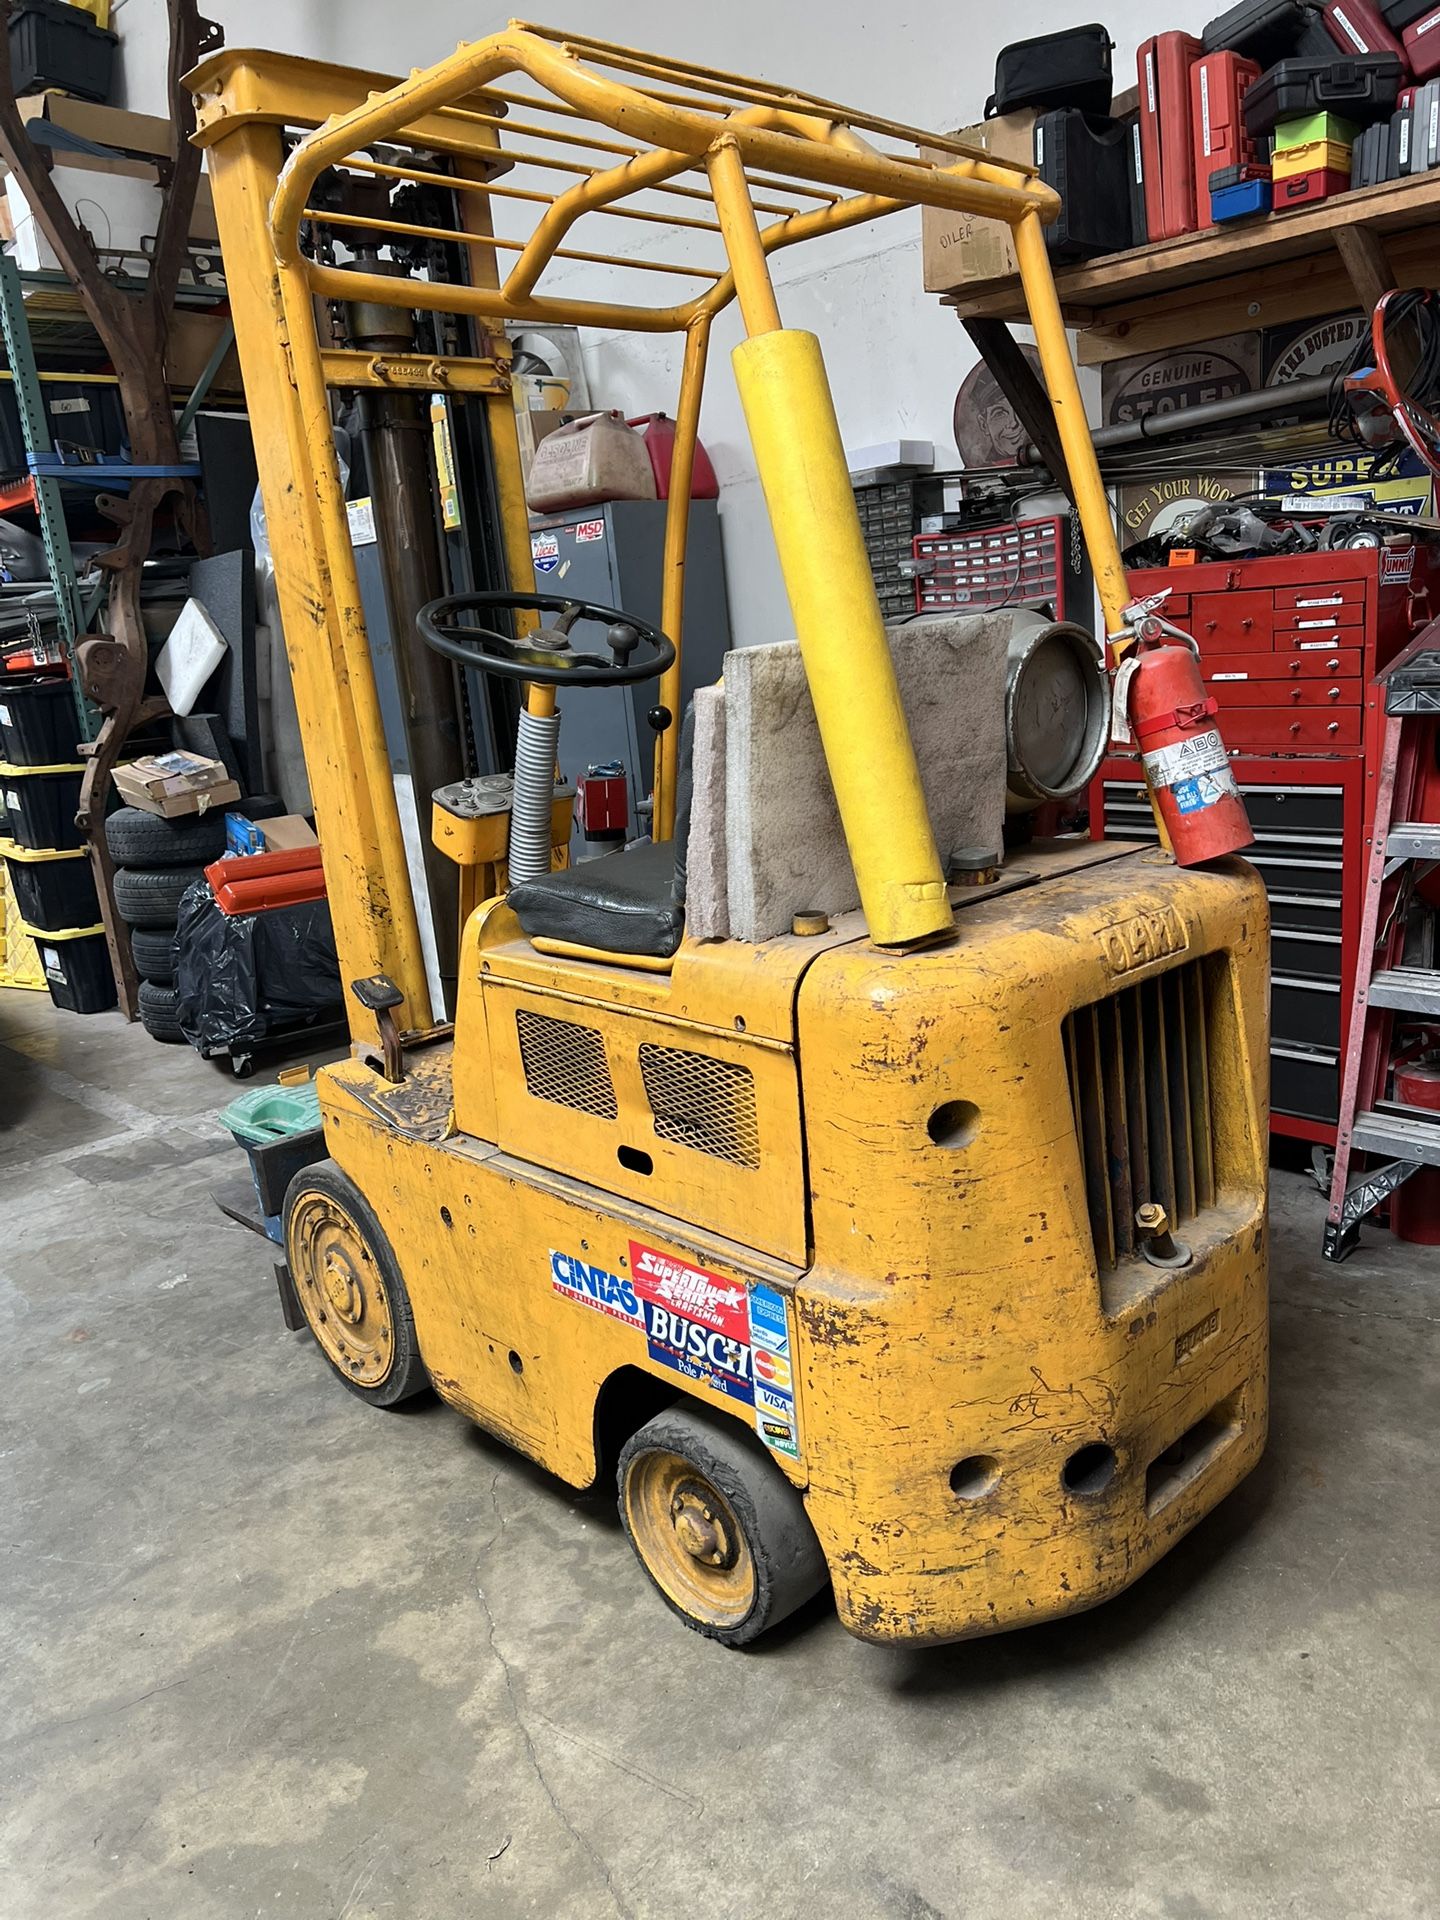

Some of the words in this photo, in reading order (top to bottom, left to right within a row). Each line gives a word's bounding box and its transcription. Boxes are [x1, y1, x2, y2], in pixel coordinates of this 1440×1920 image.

[939, 224, 974, 249] OILER
[1278, 348, 1306, 379] THE
[1304, 321, 1354, 356] BUSTED
[1141, 360, 1213, 387] GENUINE
[540, 436, 588, 459] GASOLINE
[1125, 497, 1153, 529] GET
[1149, 478, 1192, 505] YOUR
[1197, 473, 1236, 502] WOO
[577, 521, 603, 537] MSD
[535, 545, 557, 557] LUCAS
[1381, 549, 1416, 577] SUMMIT
[1107, 908, 1182, 973] CLARK
[551, 1251, 639, 1316] CINTAS
[655, 1278, 719, 1312] SERIES
[612, 1307, 643, 1328] PEOPLE
[670, 1300, 725, 1327] CRAFTSMAN
[756, 1306, 786, 1325] EXPRESS
[650, 1306, 749, 1378] BUSCH
[678, 1360, 697, 1378] Pole
[763, 1391, 788, 1412] VISA
[774, 1439, 797, 1450] NOVUS
